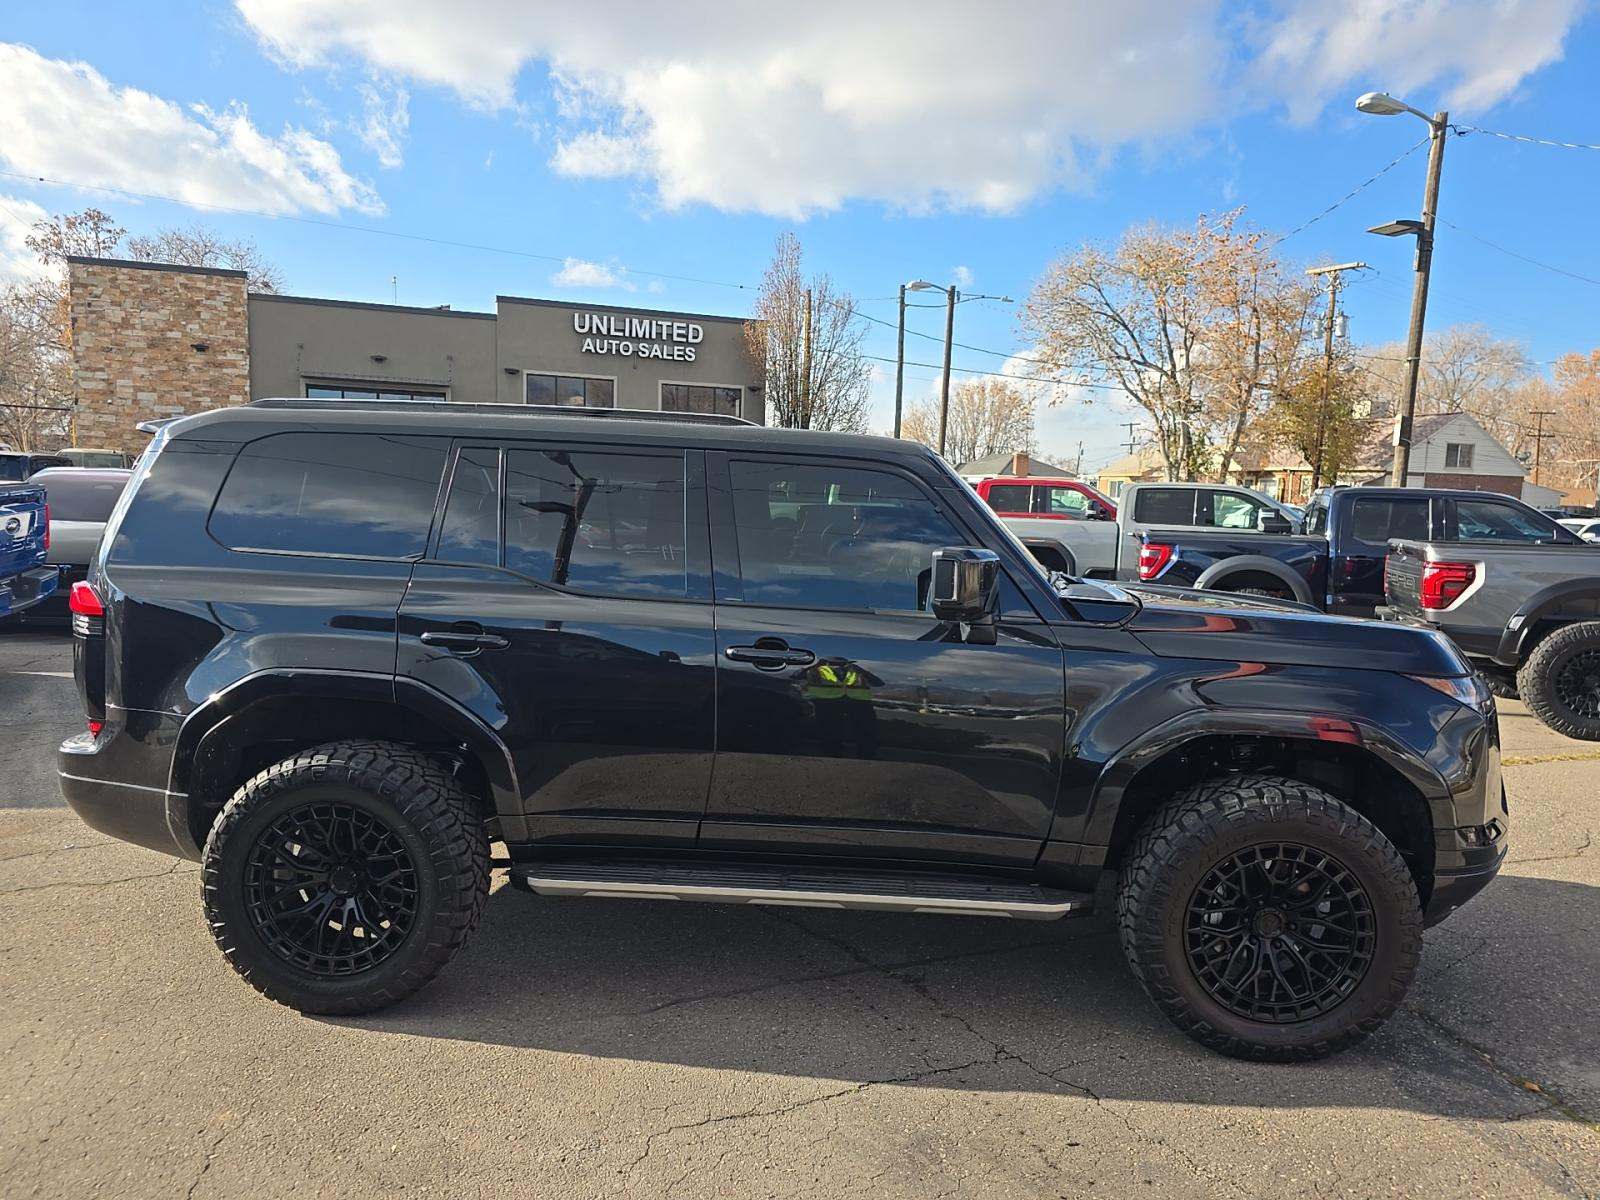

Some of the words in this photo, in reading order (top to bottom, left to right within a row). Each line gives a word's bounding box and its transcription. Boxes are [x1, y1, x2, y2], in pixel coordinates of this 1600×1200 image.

[573, 312, 704, 344] UNLIMITED
[581, 337, 633, 356] AUTO
[638, 342, 696, 362] SALES
